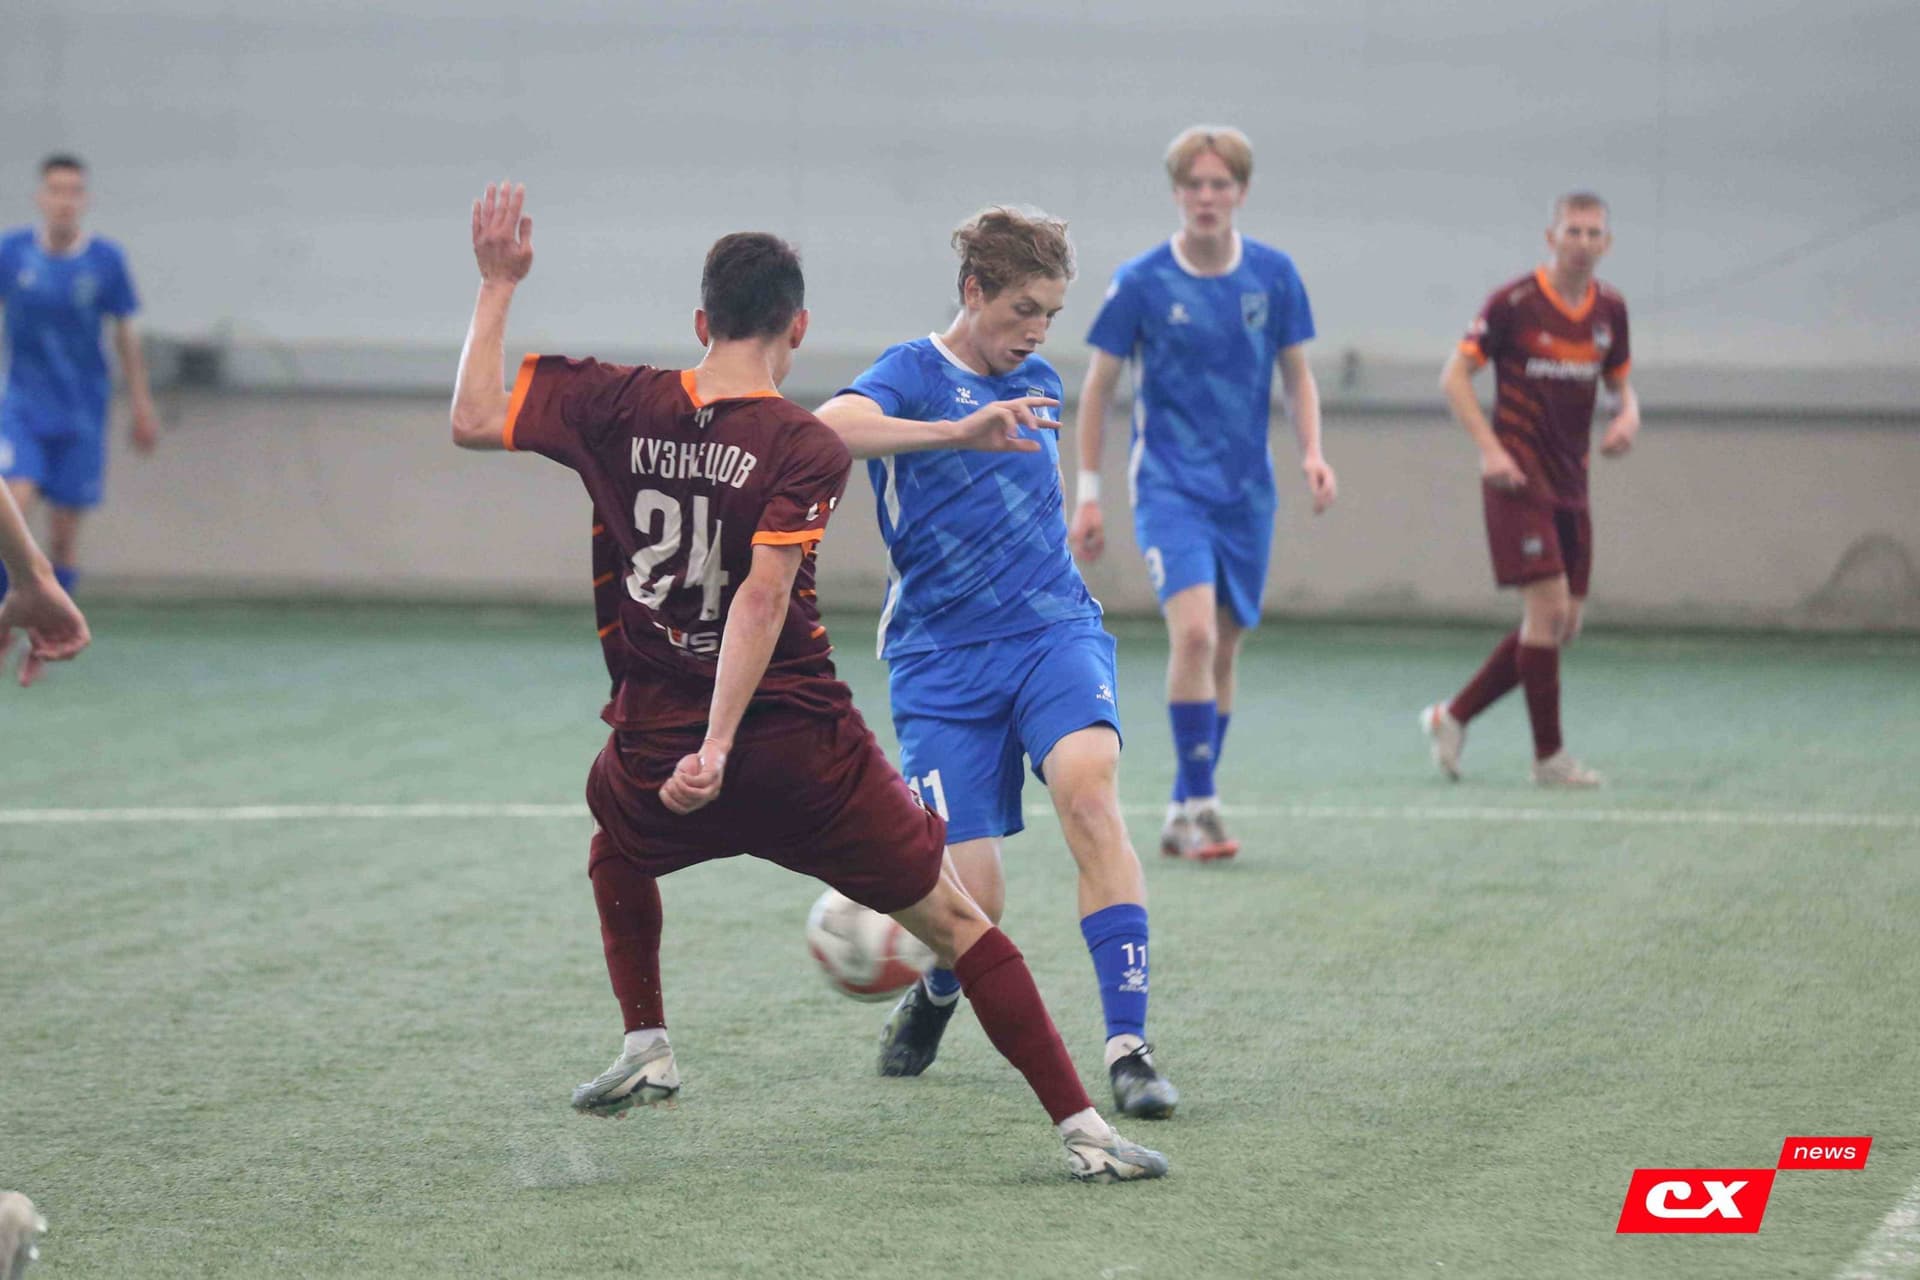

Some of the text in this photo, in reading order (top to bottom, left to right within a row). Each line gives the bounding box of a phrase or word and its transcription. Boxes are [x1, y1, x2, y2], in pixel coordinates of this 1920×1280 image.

[630, 436, 757, 489] КУЗНЕЦОВ
[625, 488, 729, 622] 24
[1120, 942, 1147, 968] 11
